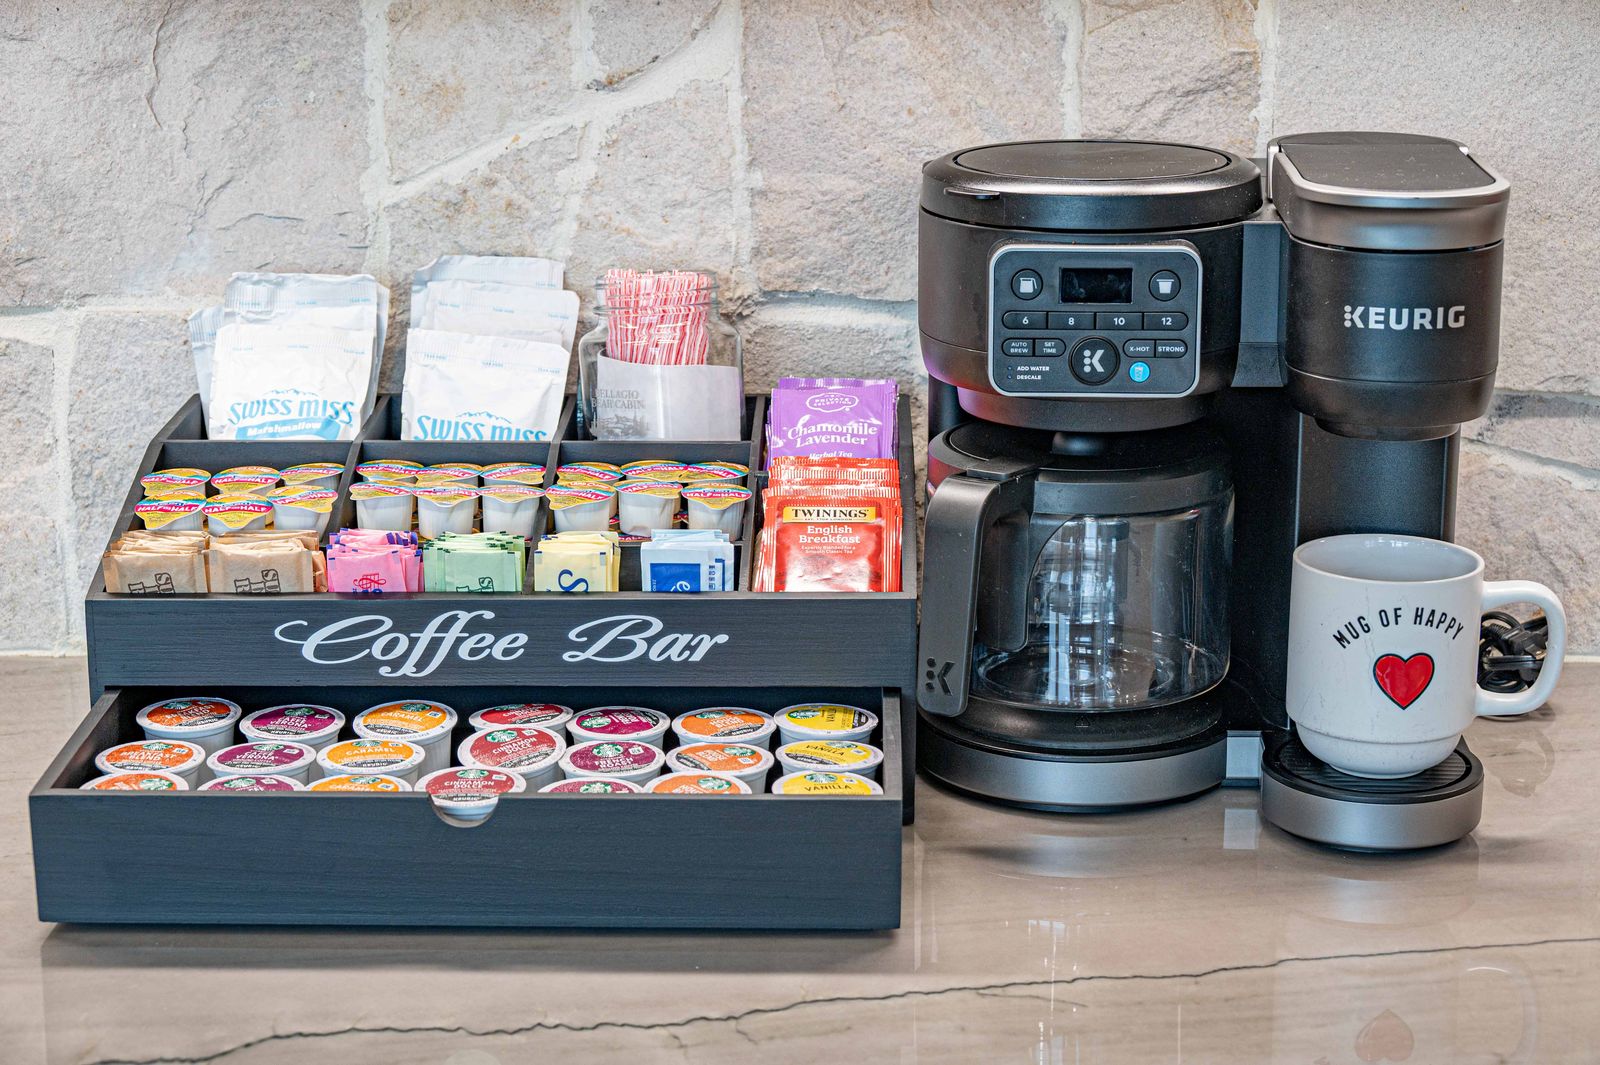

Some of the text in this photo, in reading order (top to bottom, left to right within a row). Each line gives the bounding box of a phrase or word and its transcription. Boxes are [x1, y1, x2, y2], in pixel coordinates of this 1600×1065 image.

[1022, 317, 1029, 325] 6
[1068, 318, 1075, 326] 8
[1113, 318, 1126, 326] 10
[1161, 317, 1172, 326] 12
[1344, 305, 1465, 330] KEURIG
[614, 398, 646, 410] CABIN
[247, 421, 322, 437] Marshmallow
[787, 414, 878, 440] Chamomile
[796, 433, 868, 448] Lavender
[809, 450, 853, 459] Herbal Tea
[214, 476, 276, 484] HALF HALF
[792, 508, 868, 518] TWININGS
[807, 525, 853, 535] English
[799, 535, 861, 544] Breakfast
[1333, 607, 1464, 649] MUG OF HAPPY
[274, 610, 729, 678] Coffee Bar
[492, 737, 538, 754] CINNAMON
[806, 744, 845, 756] VANILLA
[345, 748, 395, 756] CARAMEL
